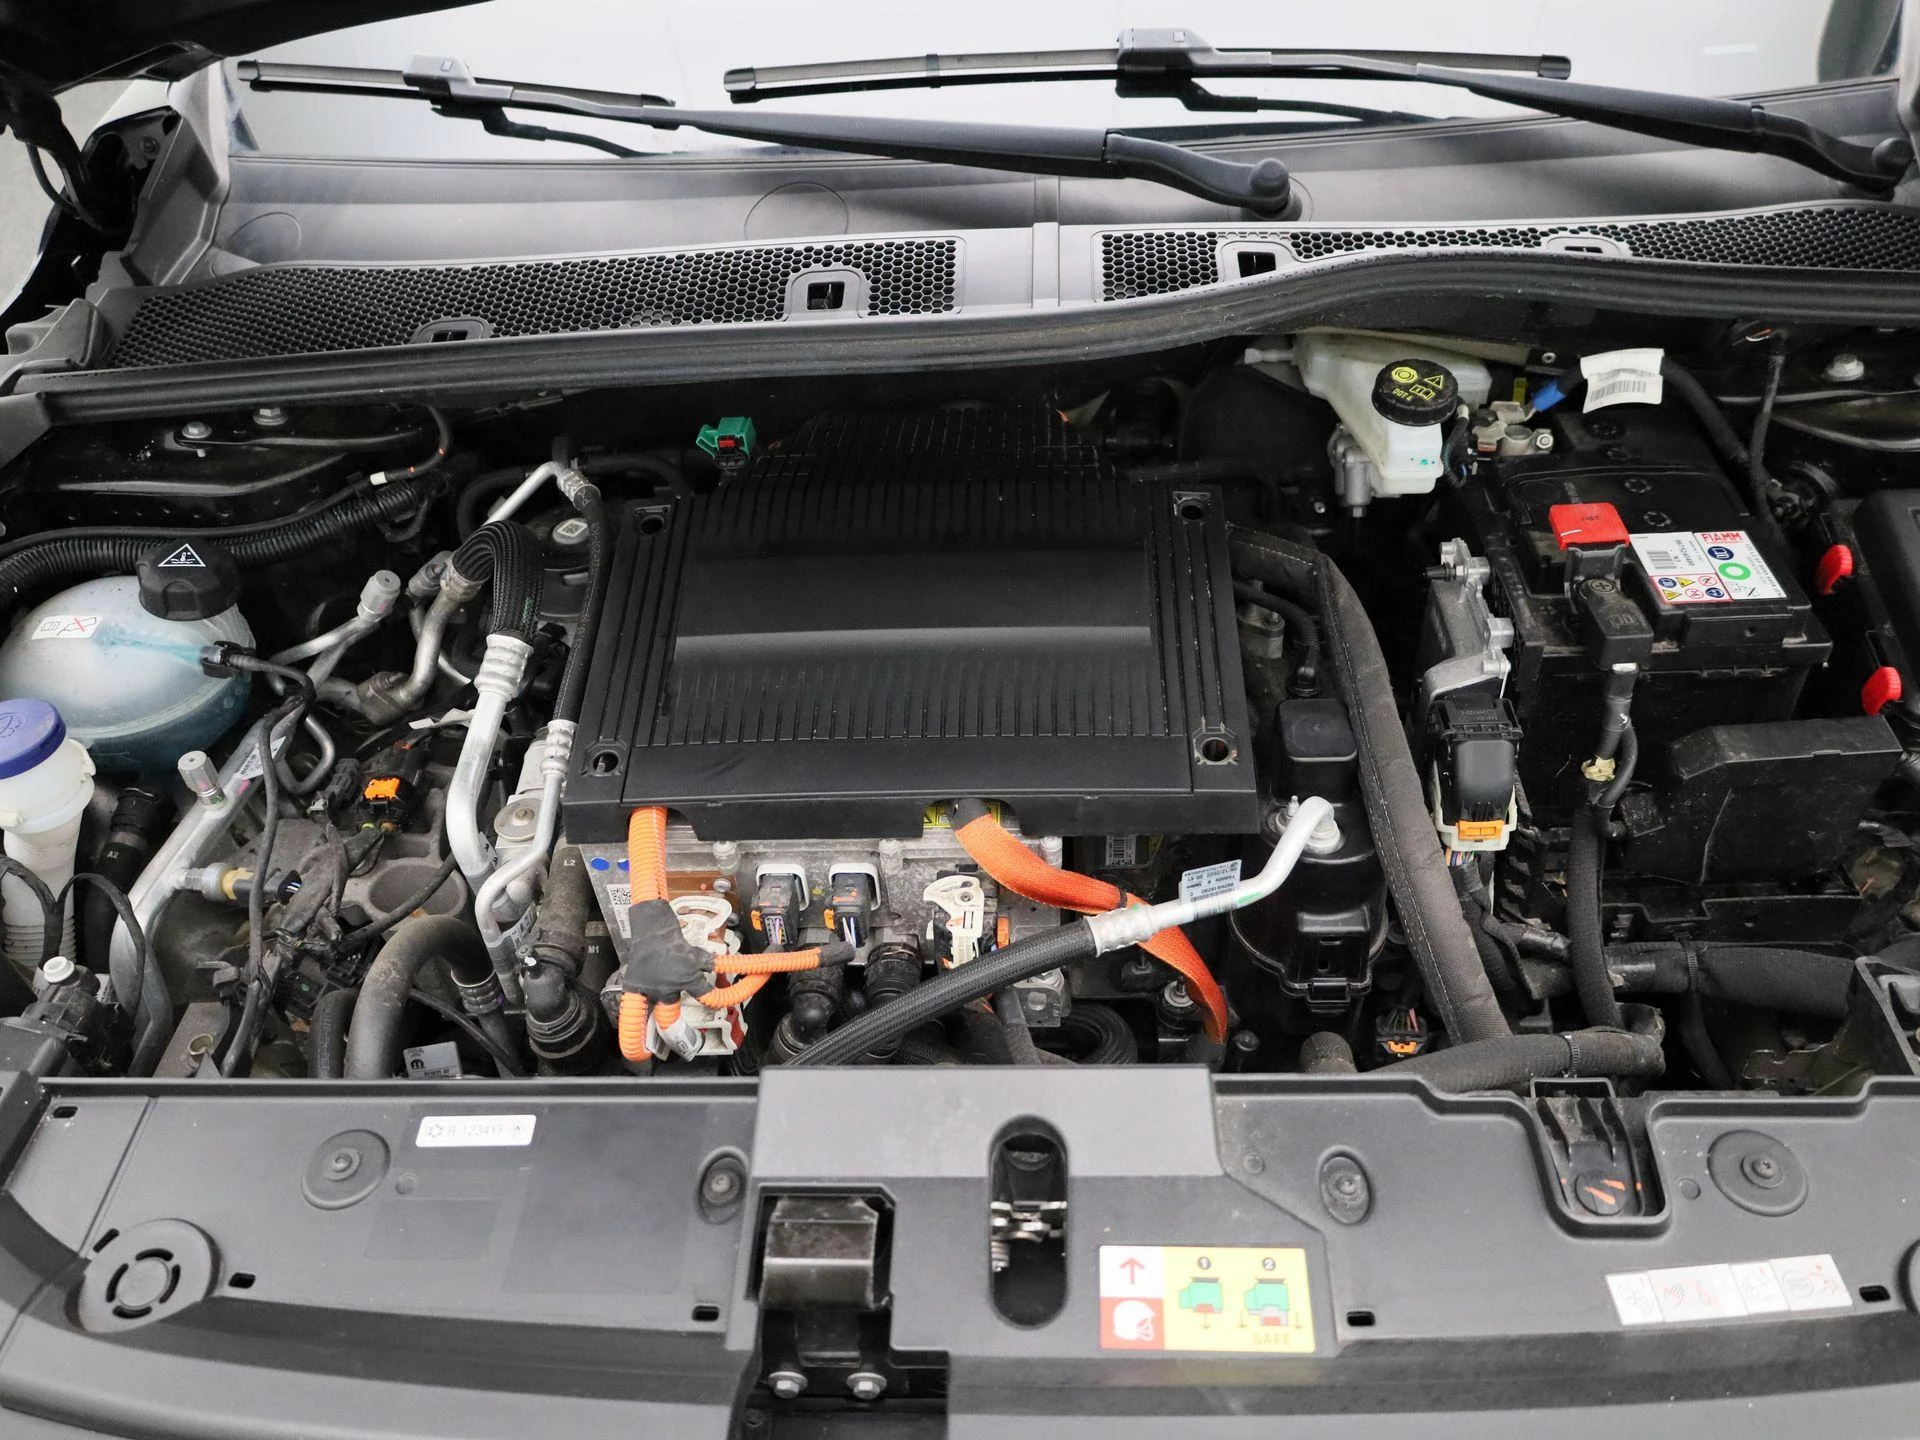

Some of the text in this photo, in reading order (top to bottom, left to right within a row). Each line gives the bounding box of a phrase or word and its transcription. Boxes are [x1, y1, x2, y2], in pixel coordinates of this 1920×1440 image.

[1701, 532, 1743, 542] FIAMM
[106, 850, 120, 859] A2
[563, 859, 576, 867] L2
[588, 944, 600, 954] M1
[1253, 1333, 1292, 1345] SAFE
